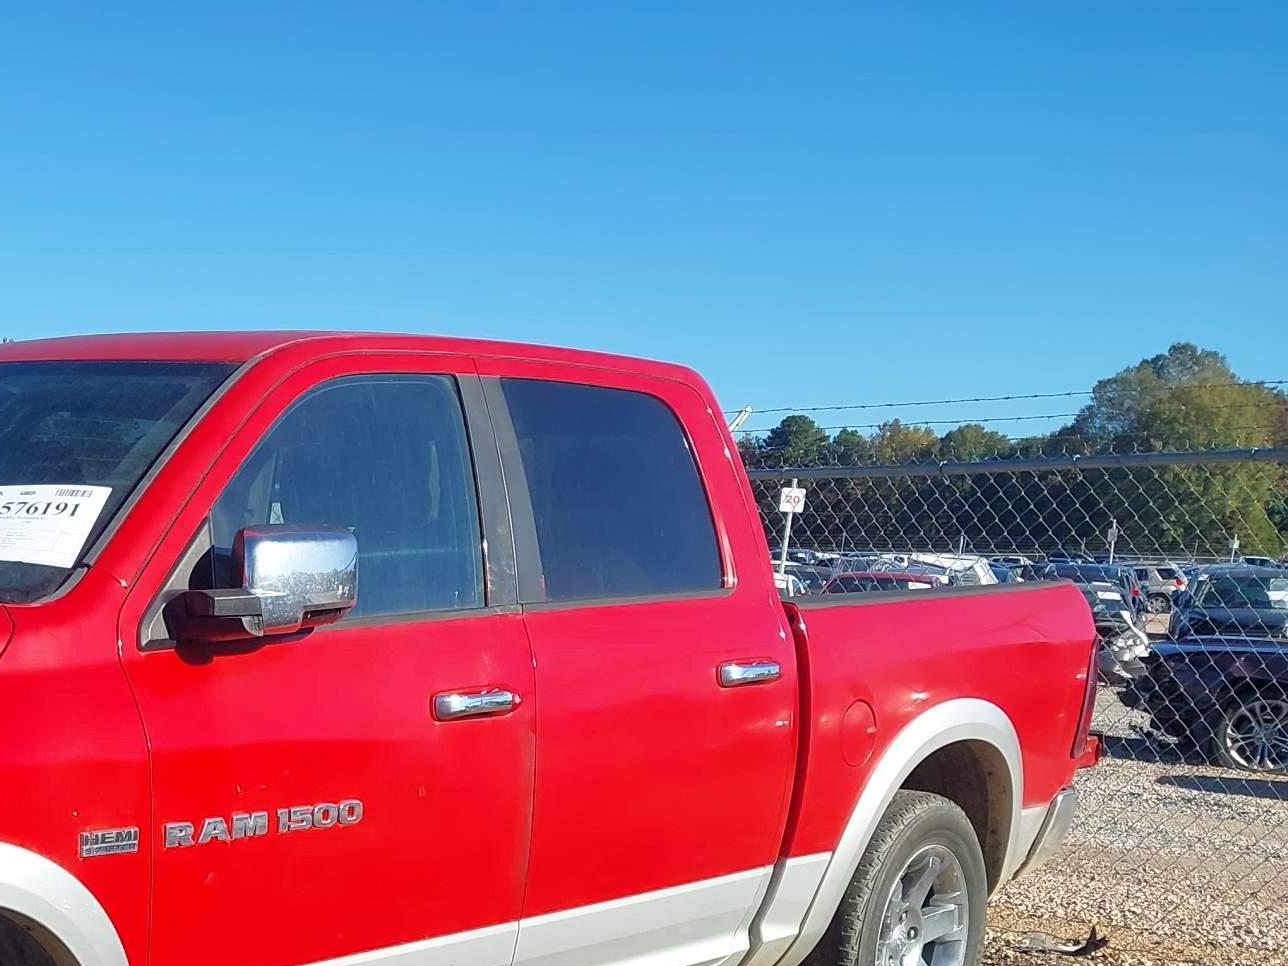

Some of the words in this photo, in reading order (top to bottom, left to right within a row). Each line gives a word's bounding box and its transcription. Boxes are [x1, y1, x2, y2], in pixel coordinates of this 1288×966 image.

[784, 495, 800, 504] 20
[165, 811, 269, 848] RAM
[277, 799, 363, 832] 1500
[84, 829, 139, 847] HEMI
